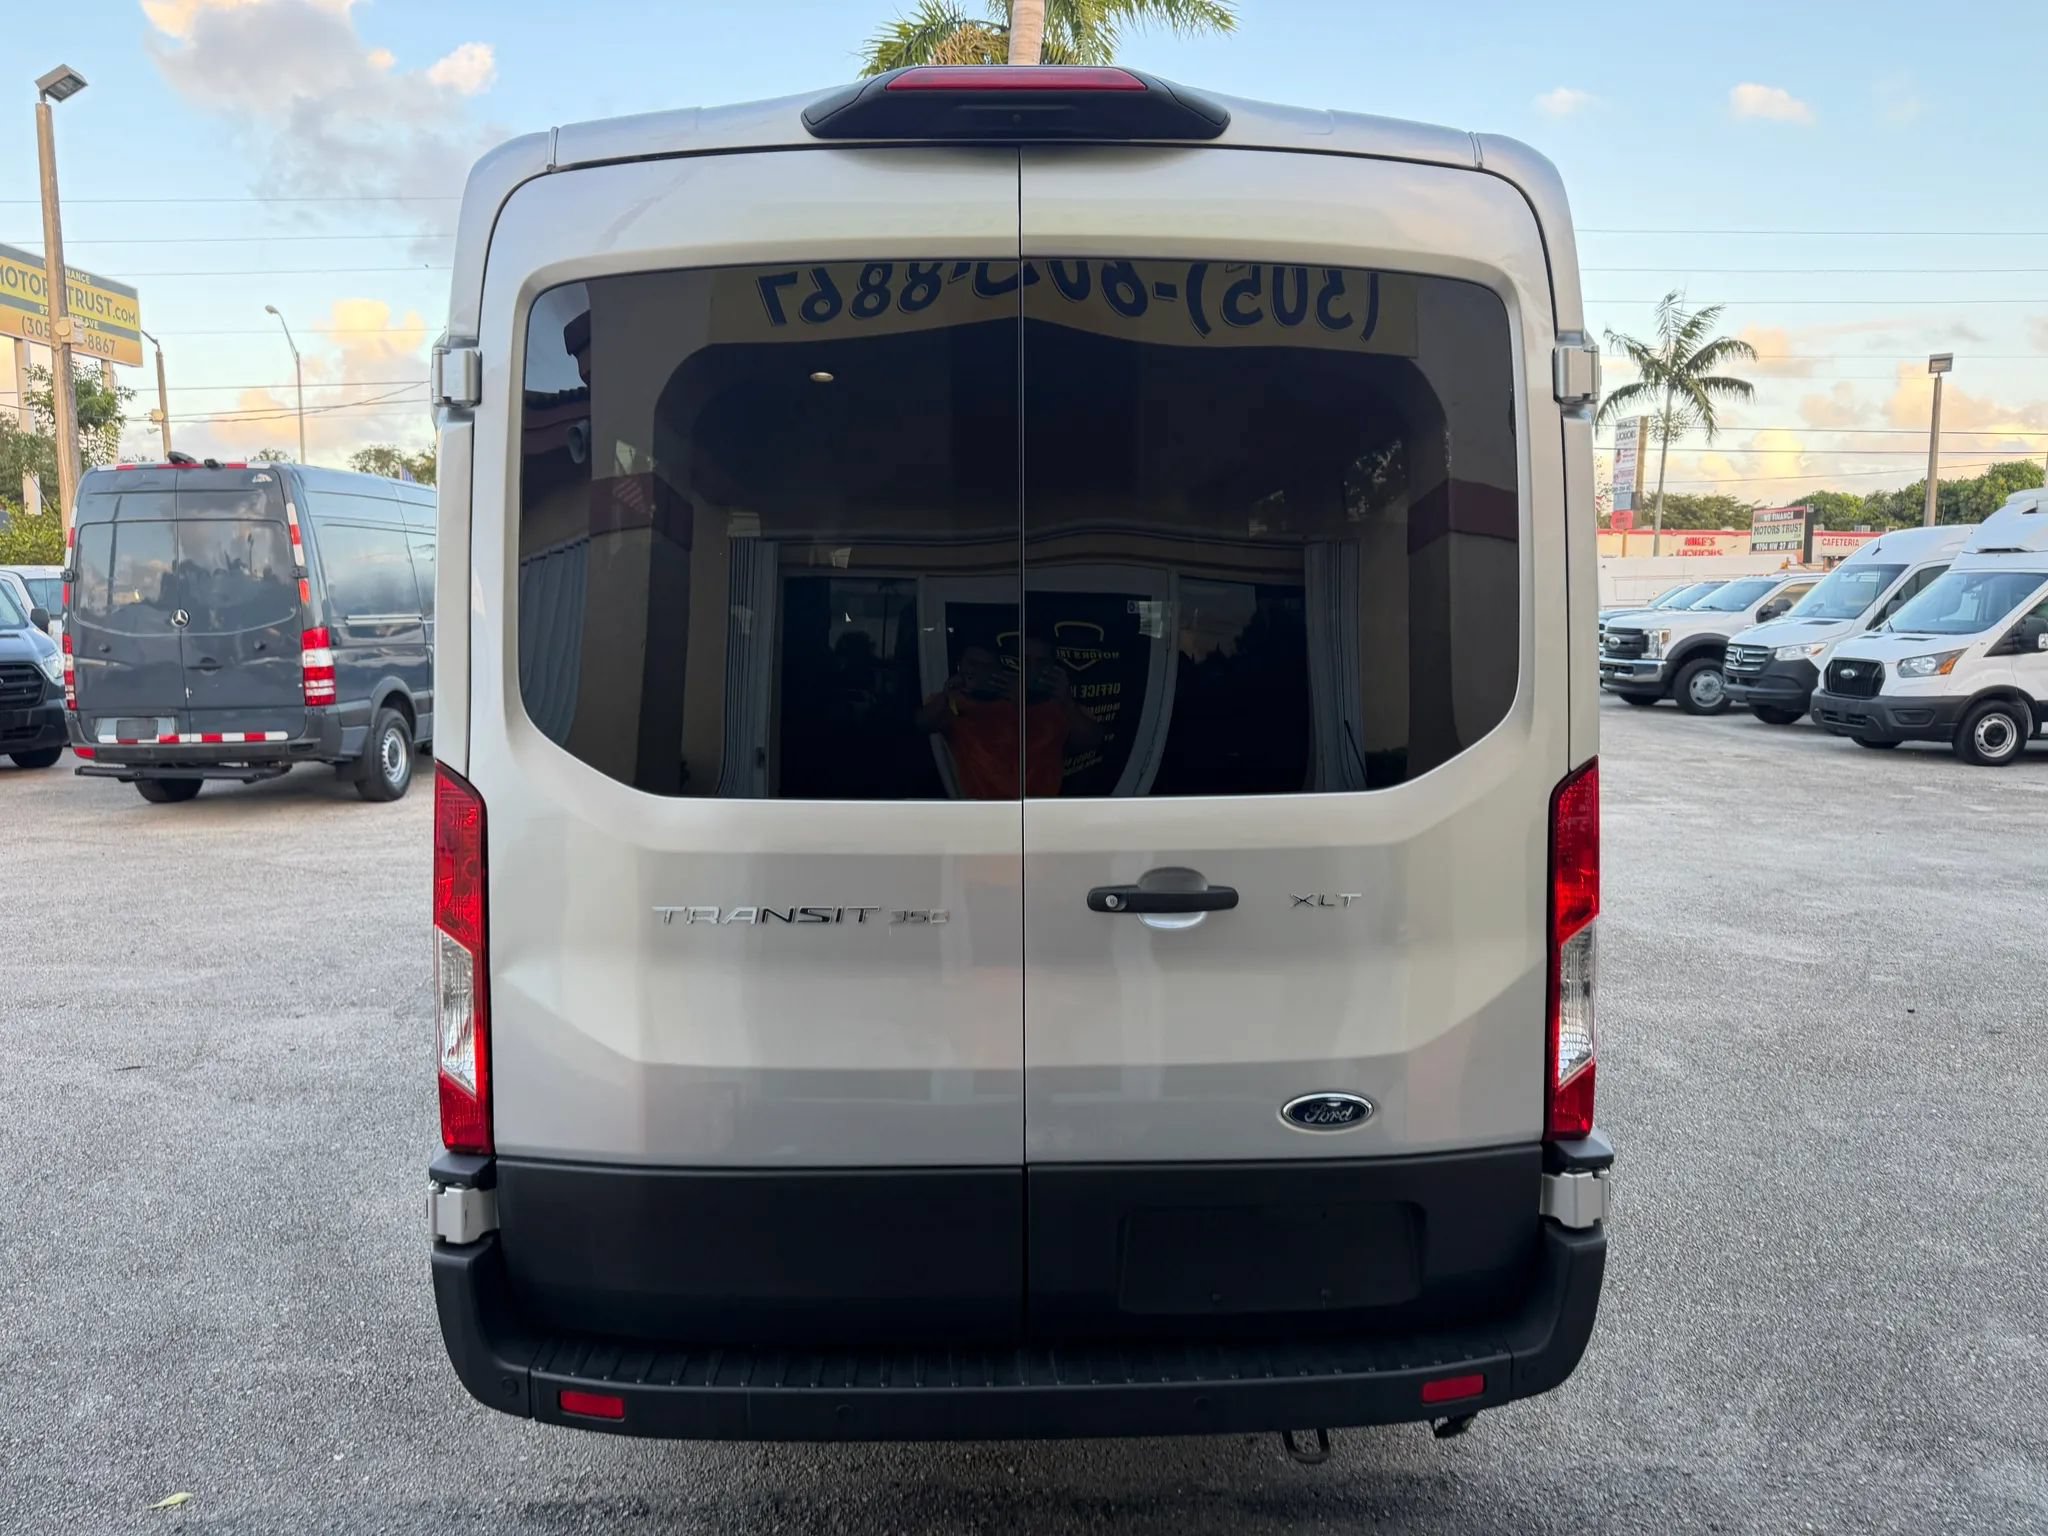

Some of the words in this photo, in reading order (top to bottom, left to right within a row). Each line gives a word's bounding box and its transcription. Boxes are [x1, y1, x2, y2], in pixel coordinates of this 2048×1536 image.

[1753, 525, 1780, 536] MOTORS
[1781, 522, 1803, 534] TRUST
[1822, 537, 1860, 547] CAFETERIA
[1290, 892, 1363, 908] XLT
[651, 905, 880, 925] TRANSIT
[889, 908, 950, 925] 350
[1304, 1101, 1354, 1124] Ford
